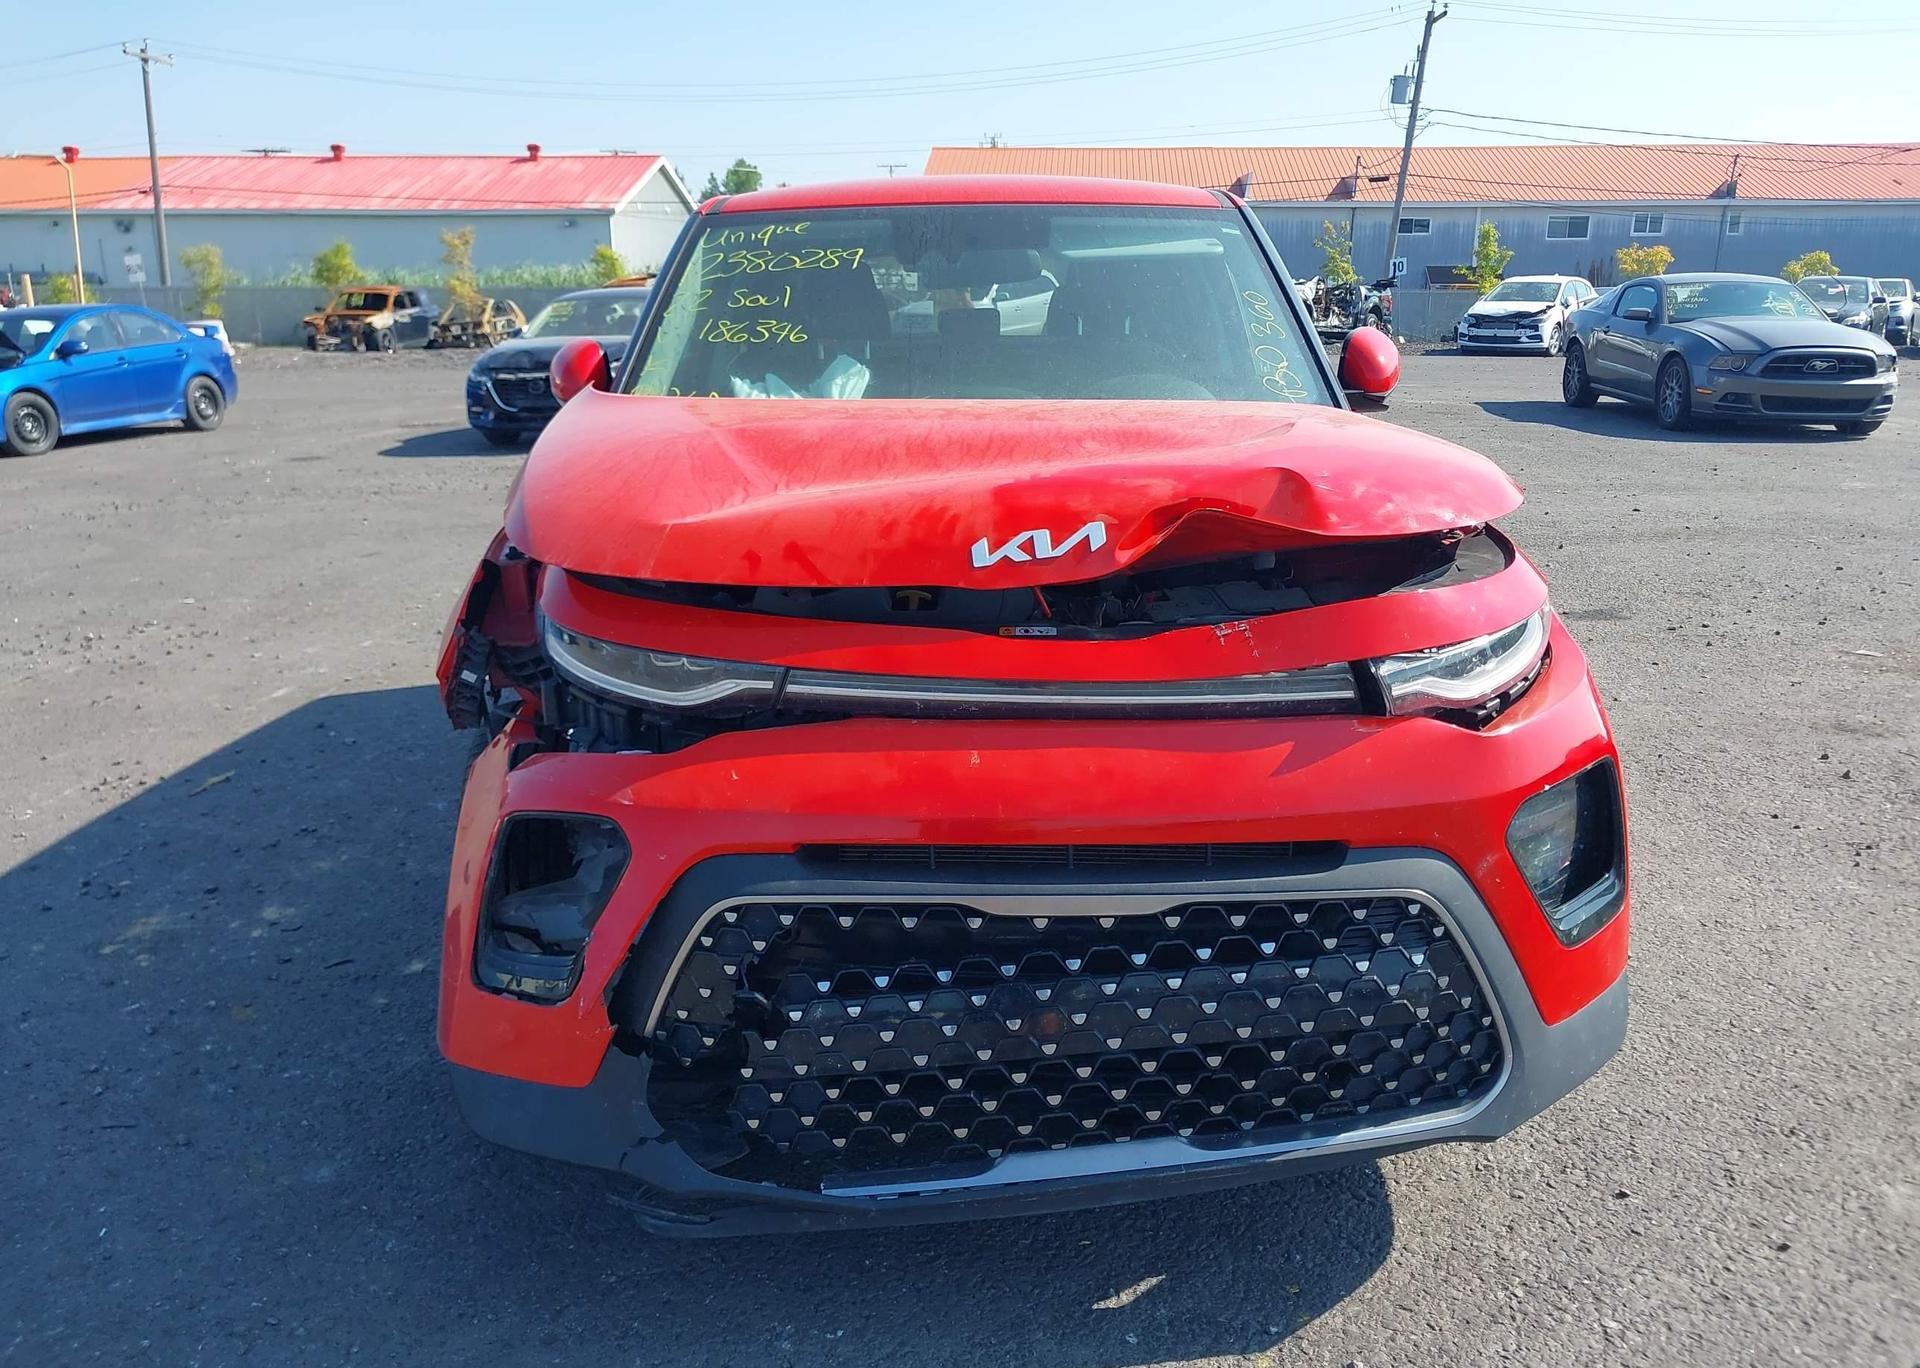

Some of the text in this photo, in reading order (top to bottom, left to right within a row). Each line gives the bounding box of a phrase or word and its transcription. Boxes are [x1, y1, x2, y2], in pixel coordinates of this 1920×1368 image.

[700, 221, 811, 247] Unique
[701, 248, 864, 280] 2380289
[728, 286, 791, 308] Soul
[972, 521, 1107, 567] KIA
